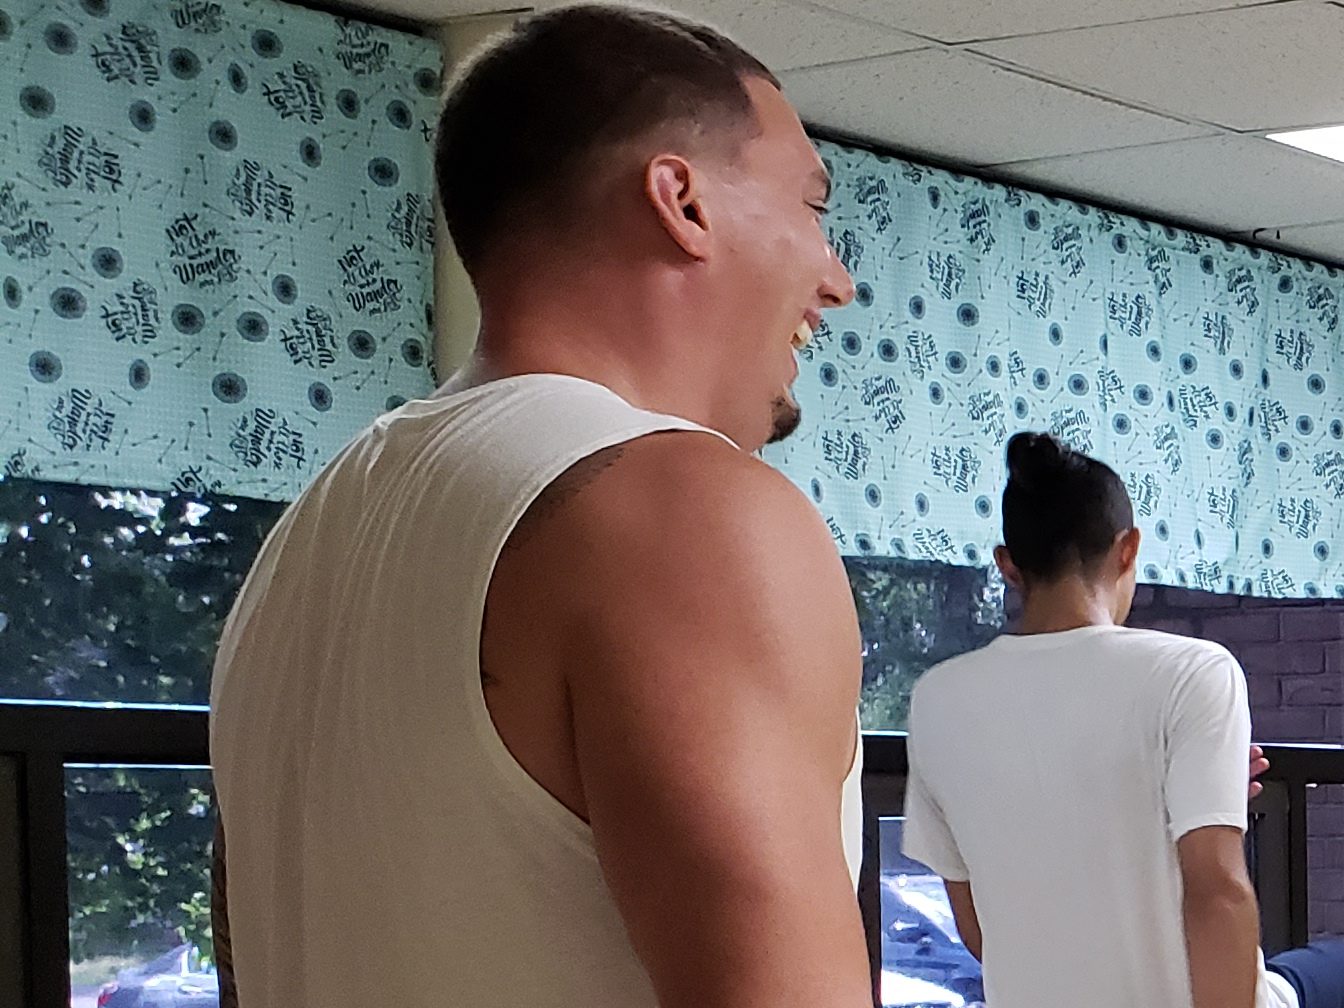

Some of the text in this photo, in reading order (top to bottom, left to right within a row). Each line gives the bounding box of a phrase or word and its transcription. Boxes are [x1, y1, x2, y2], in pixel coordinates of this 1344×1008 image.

[165, 211, 199, 242] Not
[172, 246, 242, 286] Wander
[337, 244, 366, 274] Not
[346, 277, 403, 313] Wander
